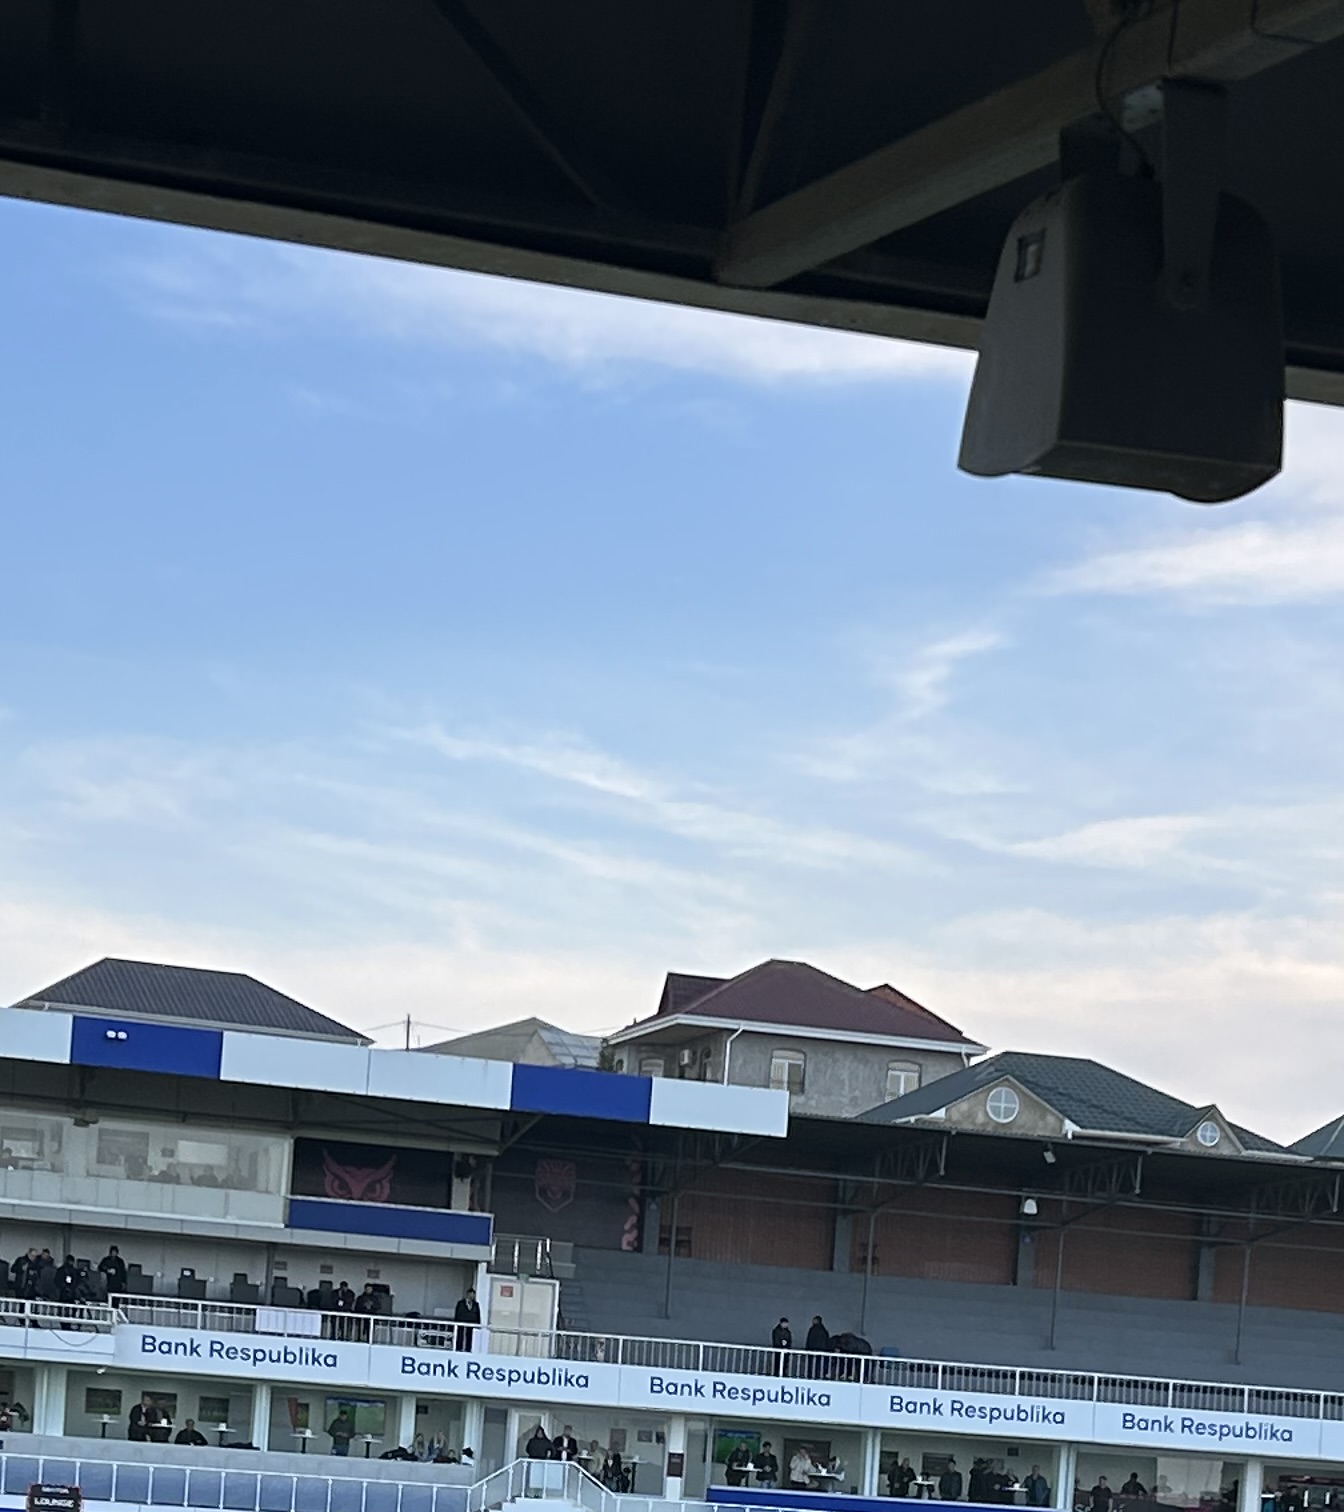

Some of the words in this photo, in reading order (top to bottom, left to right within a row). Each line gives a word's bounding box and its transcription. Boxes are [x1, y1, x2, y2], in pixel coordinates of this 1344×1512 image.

[141, 1334, 202, 1358] Bank
[209, 1339, 338, 1368] Respublika
[400, 1355, 459, 1378] Bank
[466, 1361, 589, 1389] Respublika
[650, 1376, 706, 1398] Bank
[712, 1380, 831, 1407] Respublika
[889, 1395, 944, 1417] Bank
[950, 1399, 1065, 1425] Respublika
[1122, 1412, 1174, 1433] Bank
[1180, 1416, 1293, 1442] Respublika
